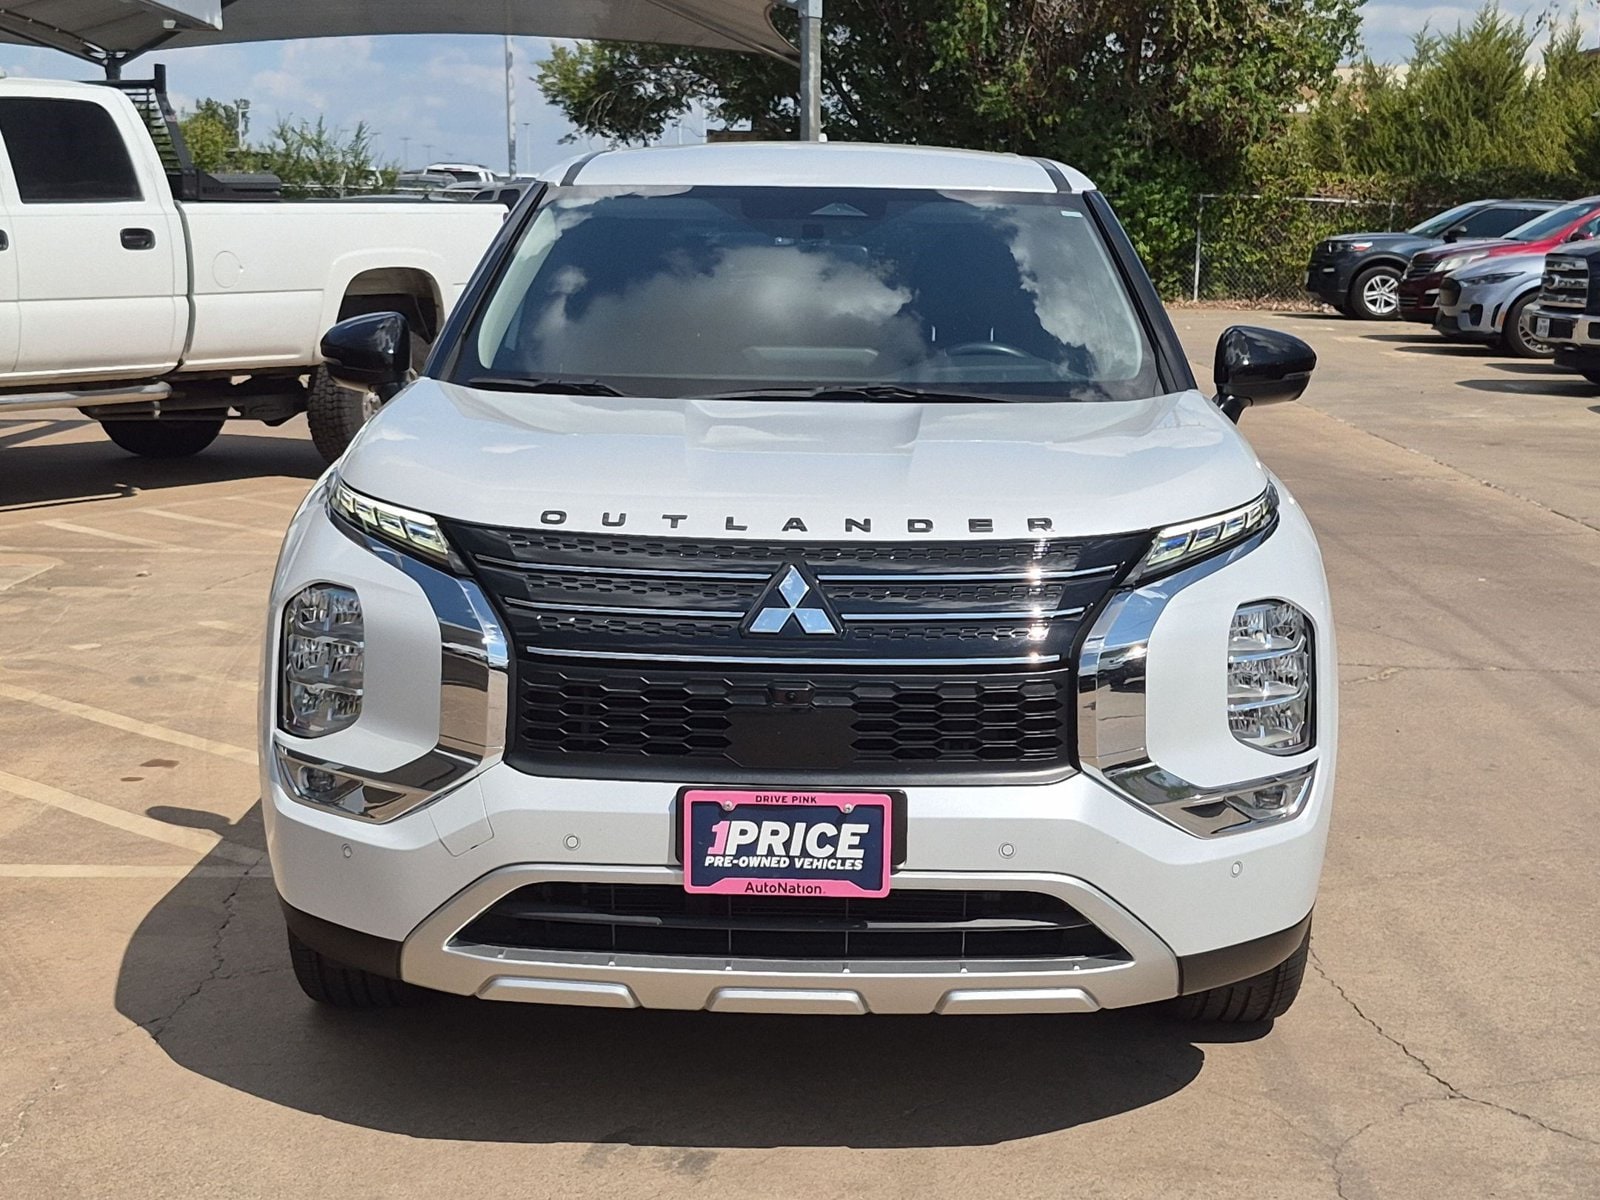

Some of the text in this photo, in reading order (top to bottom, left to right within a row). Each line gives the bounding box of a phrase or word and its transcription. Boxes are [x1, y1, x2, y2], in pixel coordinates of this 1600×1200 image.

[540, 510, 1055, 533] OUTLANDER
[755, 795, 817, 804] DRIVE PINK
[707, 820, 870, 859] 1PRICE
[704, 855, 864, 871] PRE-OWNED VEHICLES
[744, 881, 822, 895] AutoNation
